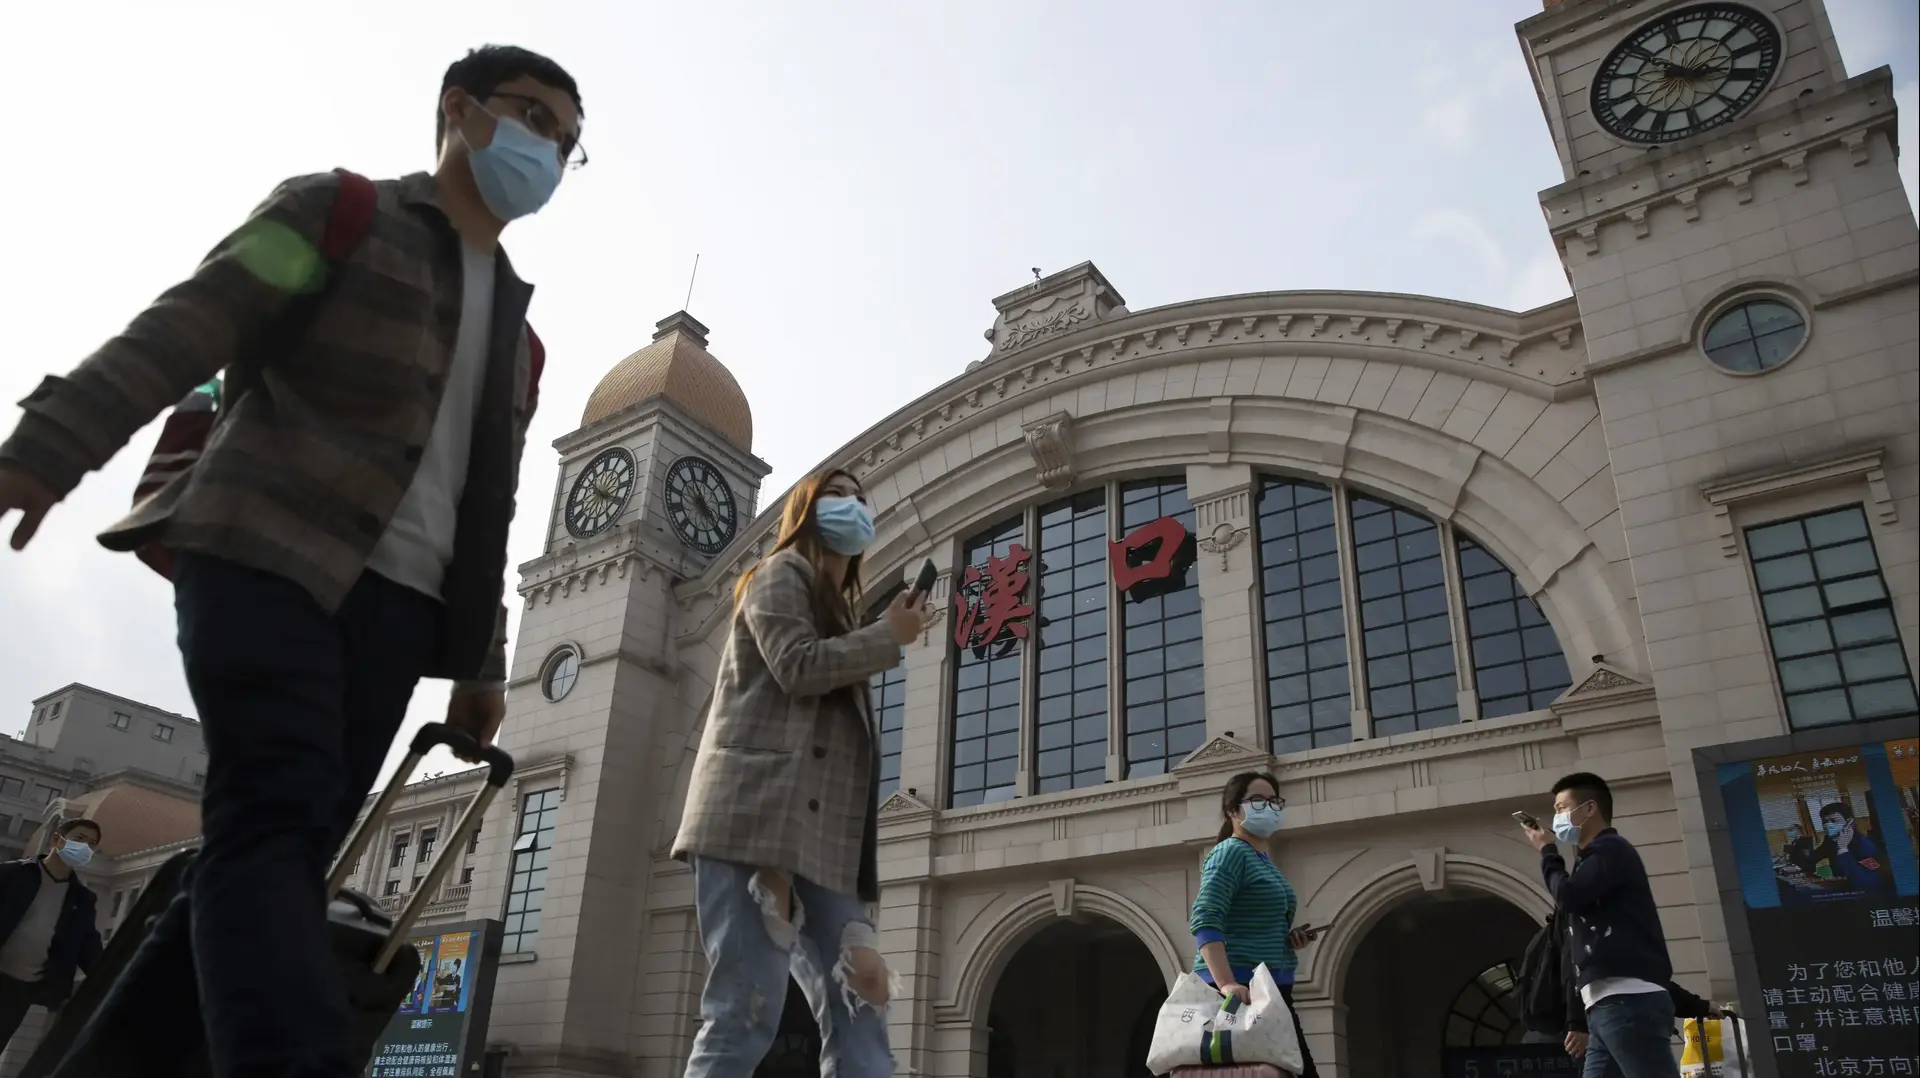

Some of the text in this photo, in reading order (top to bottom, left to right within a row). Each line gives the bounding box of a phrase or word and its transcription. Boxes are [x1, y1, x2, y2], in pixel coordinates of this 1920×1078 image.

[1768, 1005, 1919, 1030] 量，并注意排
[1772, 1033, 1829, 1053] 口罩。
[1813, 1055, 1919, 1077] 北京方向
